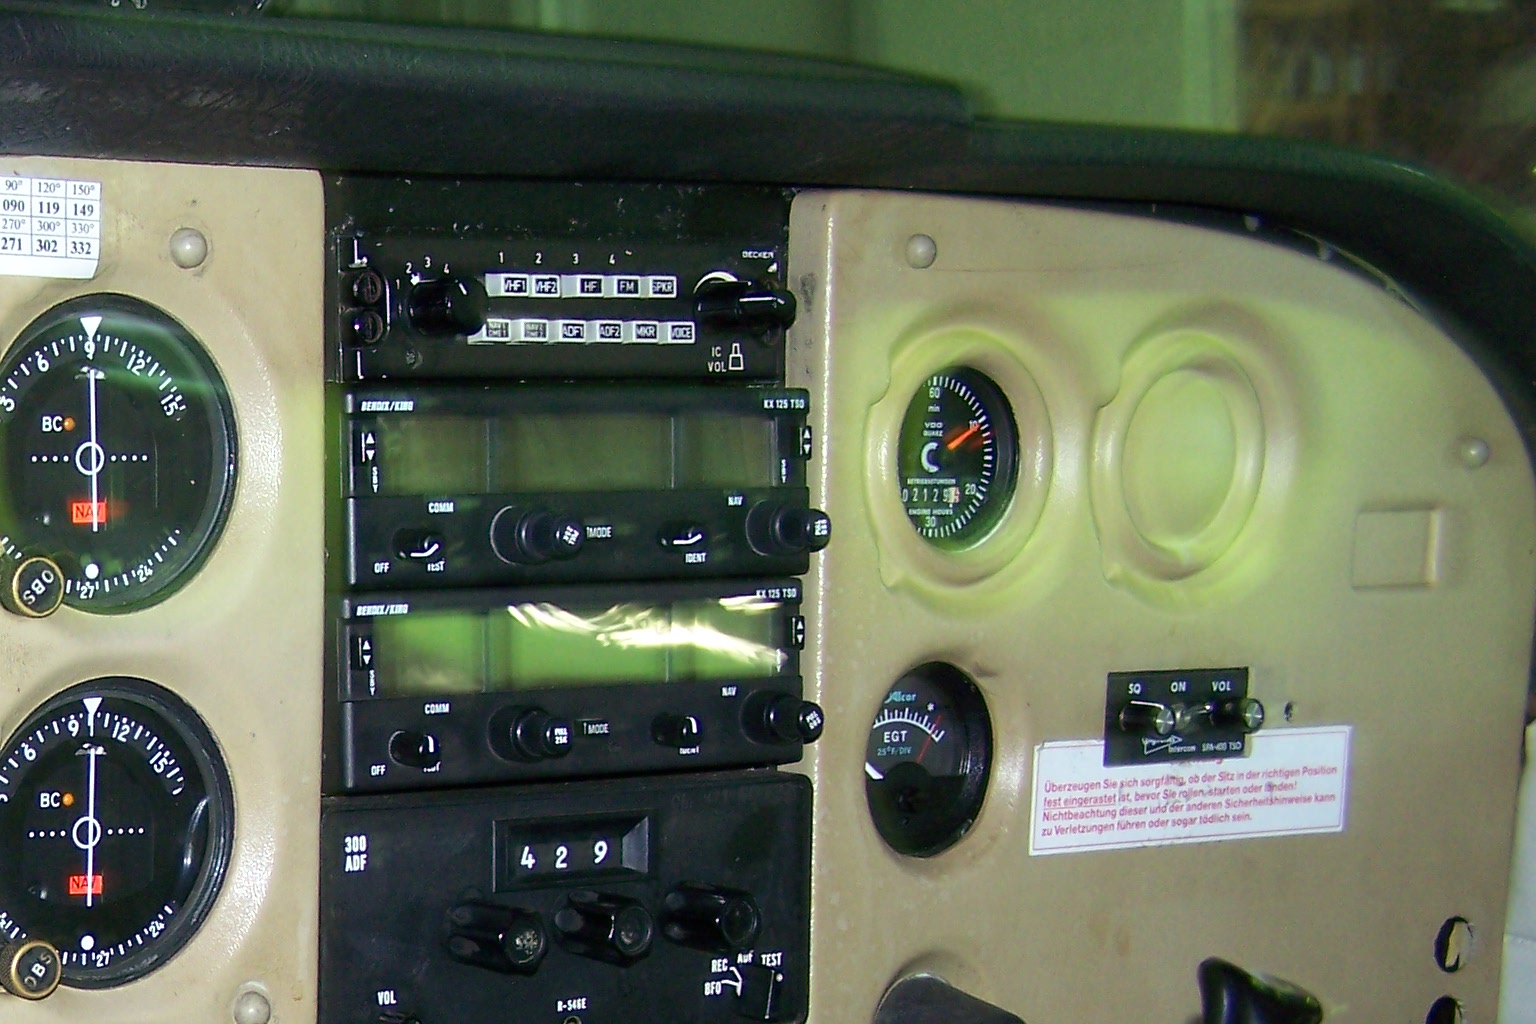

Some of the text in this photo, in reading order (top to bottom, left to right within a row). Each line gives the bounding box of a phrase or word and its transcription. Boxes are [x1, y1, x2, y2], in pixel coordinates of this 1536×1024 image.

[2, 199, 25, 213] 090
[38, 202, 60, 215] 119
[73, 204, 94, 217] 149
[1, 237, 22, 252] 271
[36, 240, 58, 253] 302
[70, 241, 91, 256] 332
[707, 361, 726, 373] VOL
[764, 399, 774, 409] KX
[776, 399, 789, 409] 125
[428, 502, 454, 514] COMM
[727, 496, 743, 507] NAV
[1128, 680, 1231, 695] SQ ON VOL
[883, 730, 908, 744] EGT
[1044, 780, 1101, 793] Überzeugen
[1103, 779, 1117, 789] Sie
[1119, 777, 1138, 788] sich
[1188, 774, 1199, 783] ob
[1202, 772, 1216, 782] der
[1218, 771, 1234, 781] Sitz
[1236, 771, 1245, 780] in
[1246, 769, 1260, 779] der
[1262, 767, 1300, 779] richtigen
[1302, 766, 1337, 777] Position
[1043, 797, 1061, 807] fest
[1064, 794, 1116, 807] eingerastet
[1135, 791, 1160, 801] bevor
[1162, 789, 1177, 799] Sie
[1208, 786, 1240, 796] starten
[1242, 784, 1262, 794] oder
[1042, 808, 1117, 822] Nichtbeachtung
[1119, 805, 1148, 816] dieser
[1150, 804, 1167, 814] und
[1169, 802, 1184, 813] der
[1186, 801, 1222, 811] anderen
[1315, 793, 1336, 803] kann
[1042, 812, 1252, 836] zu Verletzungen führen oder sogar tödlich sein.
[345, 835, 367, 853] 300
[345, 854, 367, 872] ADF
[711, 958, 729, 973] REC
[761, 951, 782, 967] TEST
[704, 981, 722, 996] BFO
[377, 990, 397, 1005] VOL
